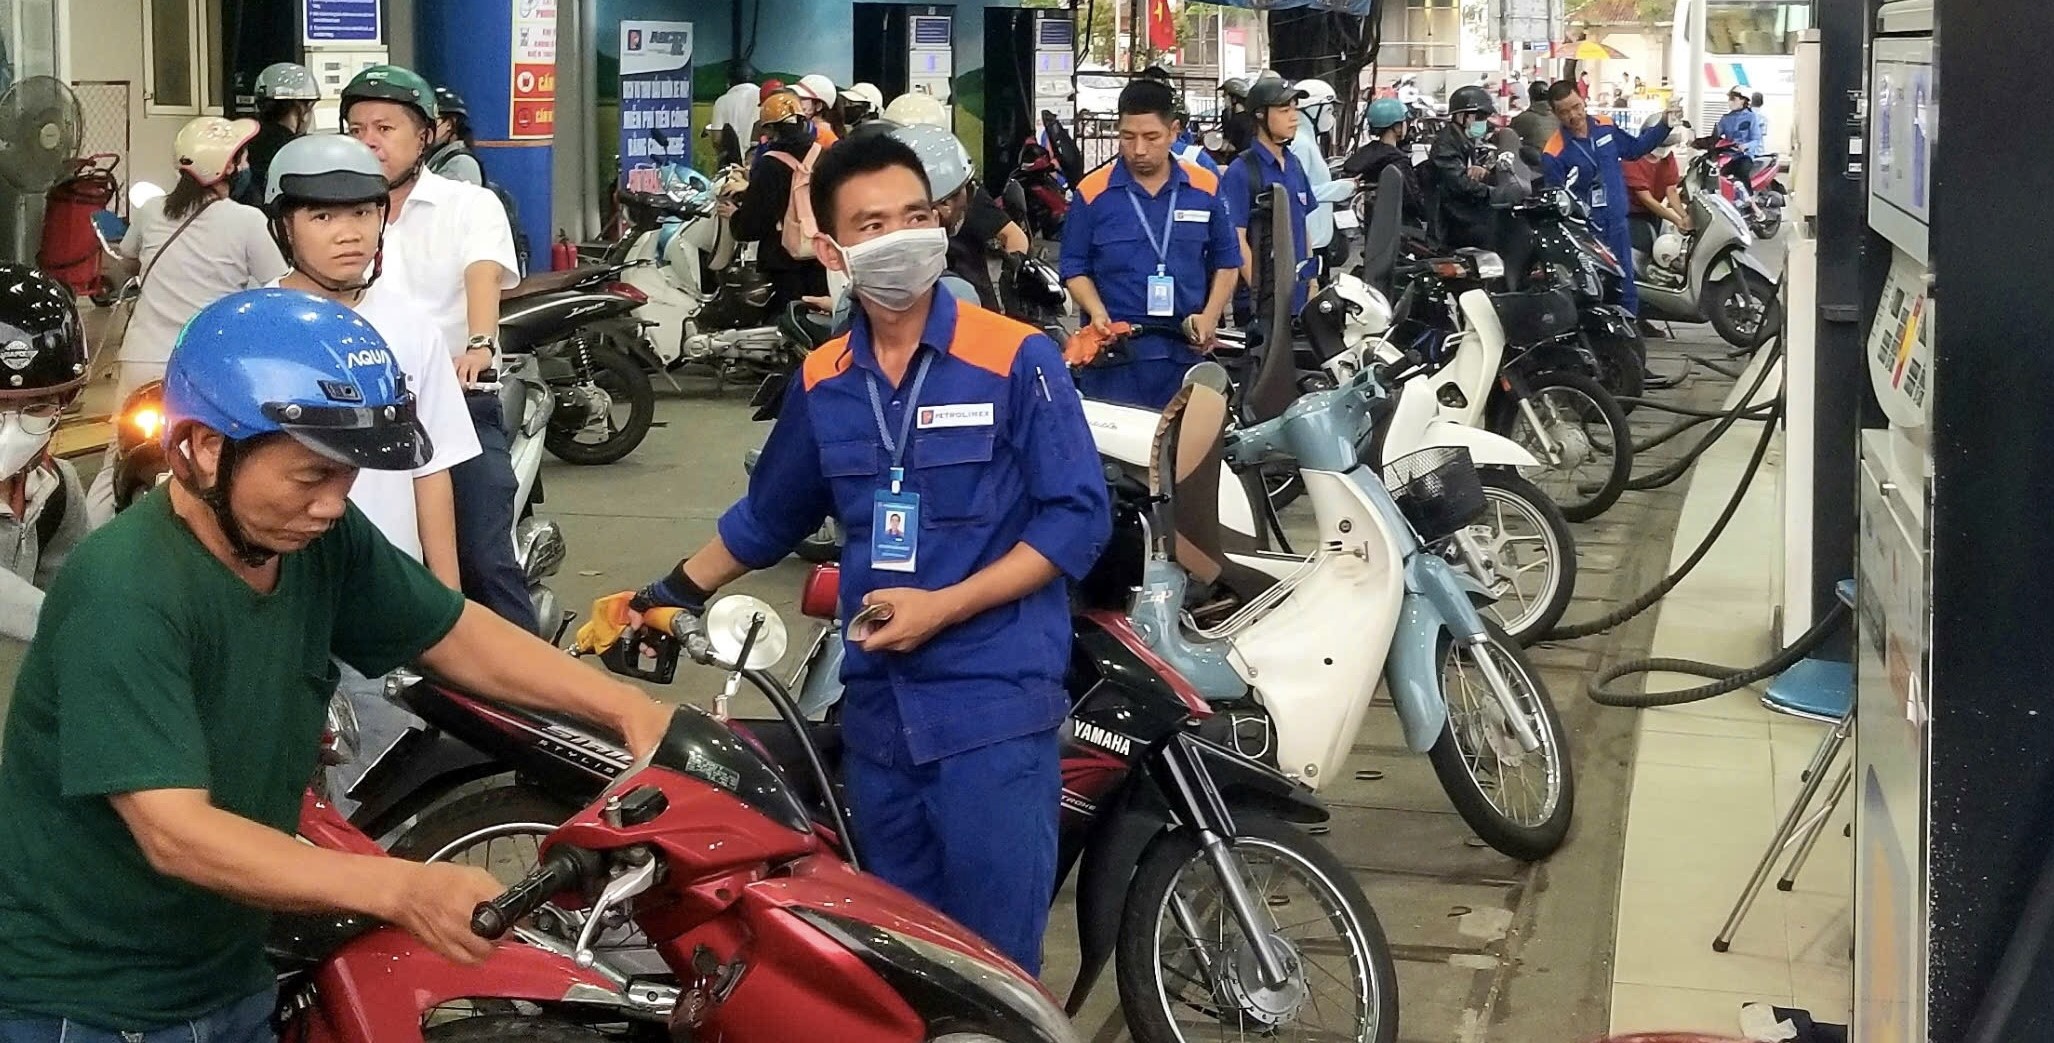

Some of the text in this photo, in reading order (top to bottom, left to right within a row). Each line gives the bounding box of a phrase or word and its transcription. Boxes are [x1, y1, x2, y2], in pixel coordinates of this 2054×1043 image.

[348, 349, 390, 369] AQUA
[1074, 719, 1131, 756] YAMAHA
[1060, 794, 1096, 811] TROKE
